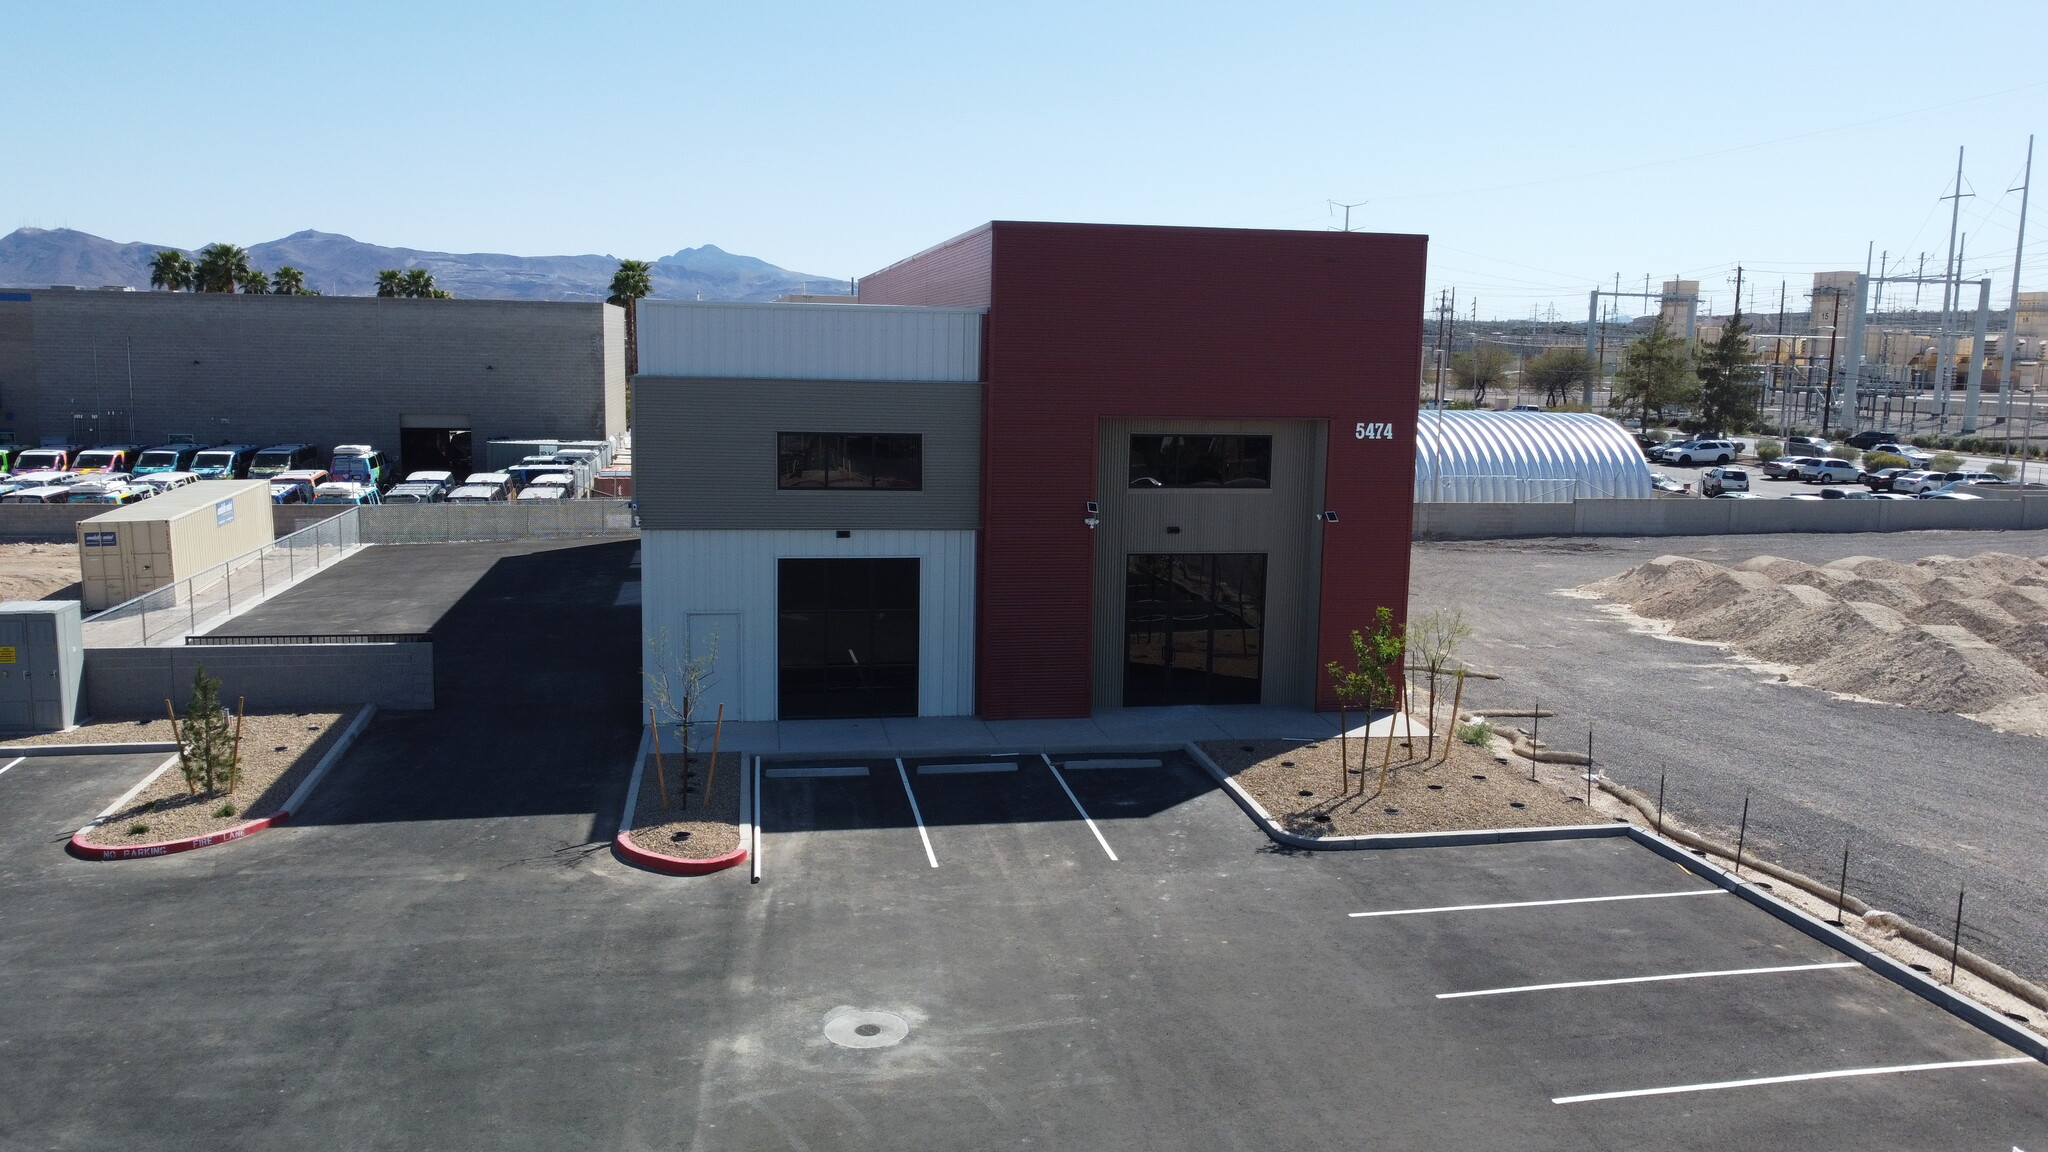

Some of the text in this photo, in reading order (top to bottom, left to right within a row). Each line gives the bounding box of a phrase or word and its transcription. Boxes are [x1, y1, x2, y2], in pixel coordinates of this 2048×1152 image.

[1821, 312, 1829, 320] 15
[1355, 422, 1393, 439] 5474
[193, 829, 245, 849] FIRE LANE
[103, 846, 167, 859] NO PARKING
